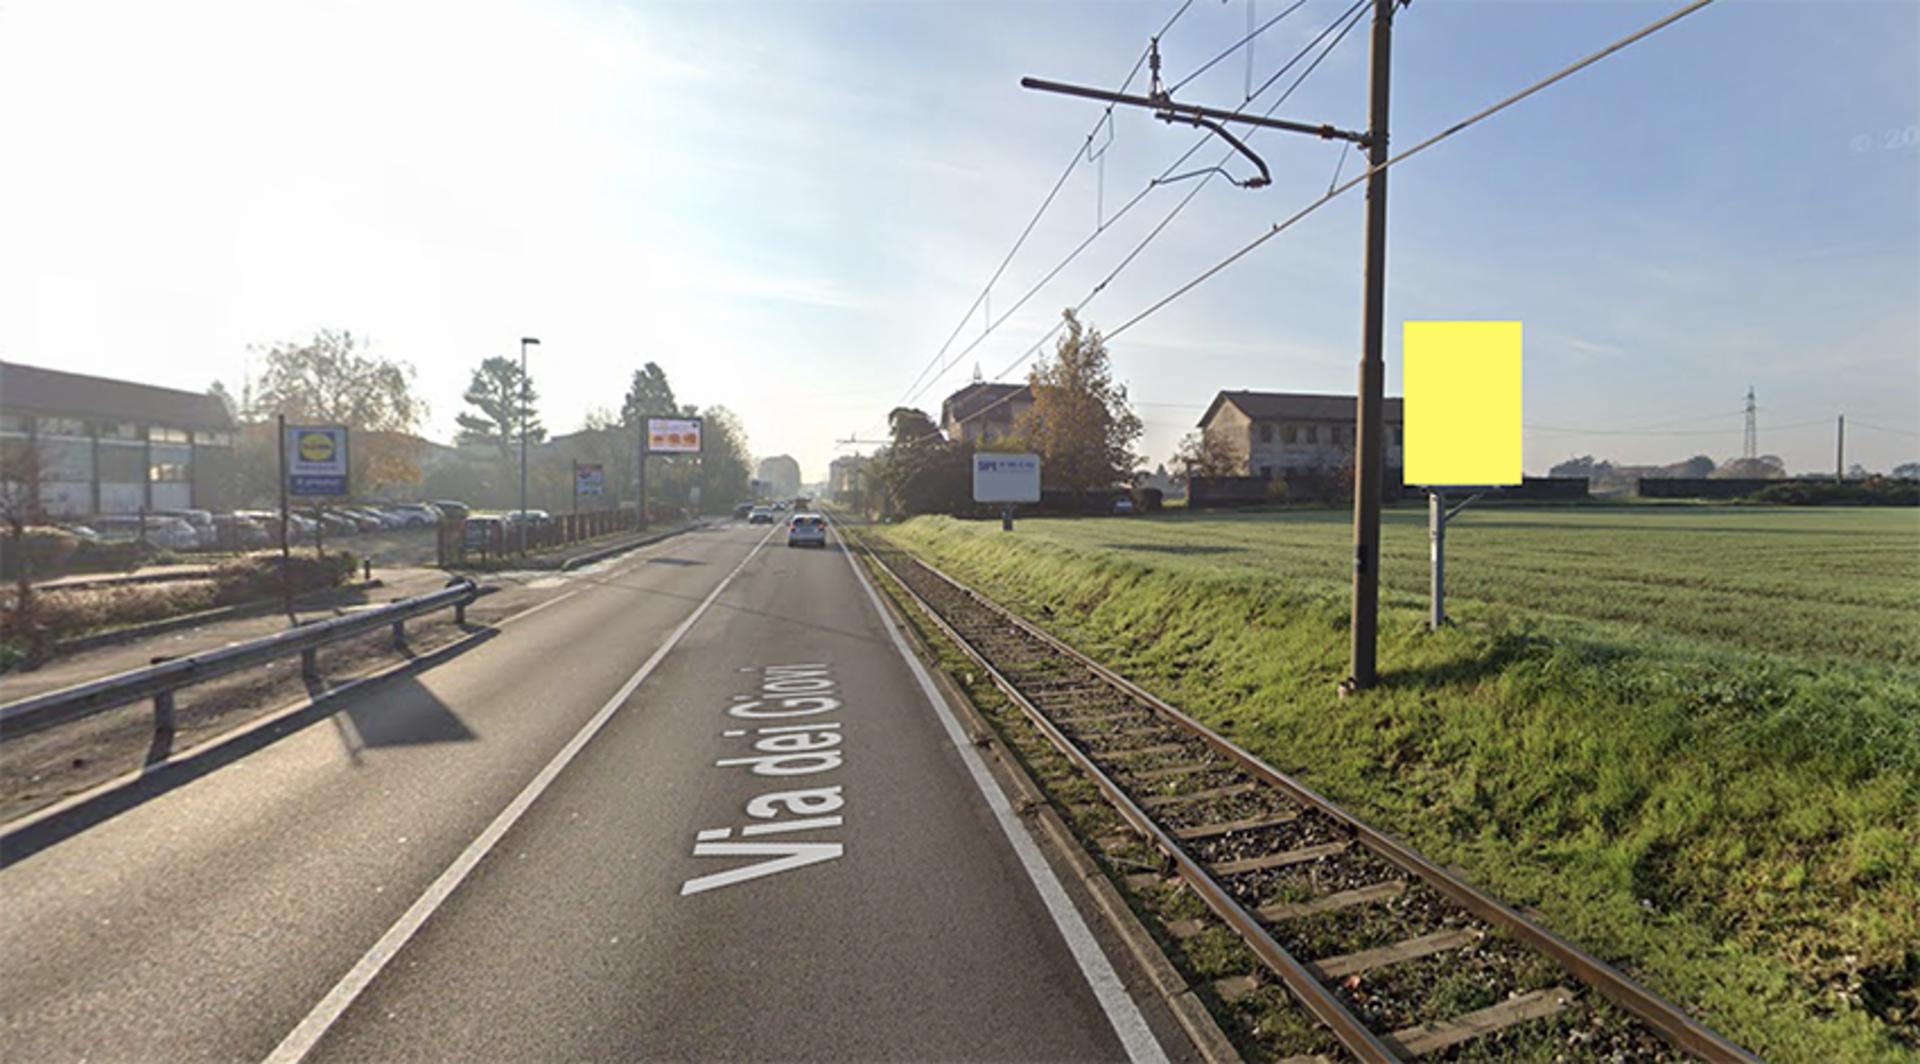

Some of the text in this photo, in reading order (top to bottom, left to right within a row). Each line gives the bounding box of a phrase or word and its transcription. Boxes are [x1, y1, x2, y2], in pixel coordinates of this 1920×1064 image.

[681, 663, 845, 896] Via dei Giovi
